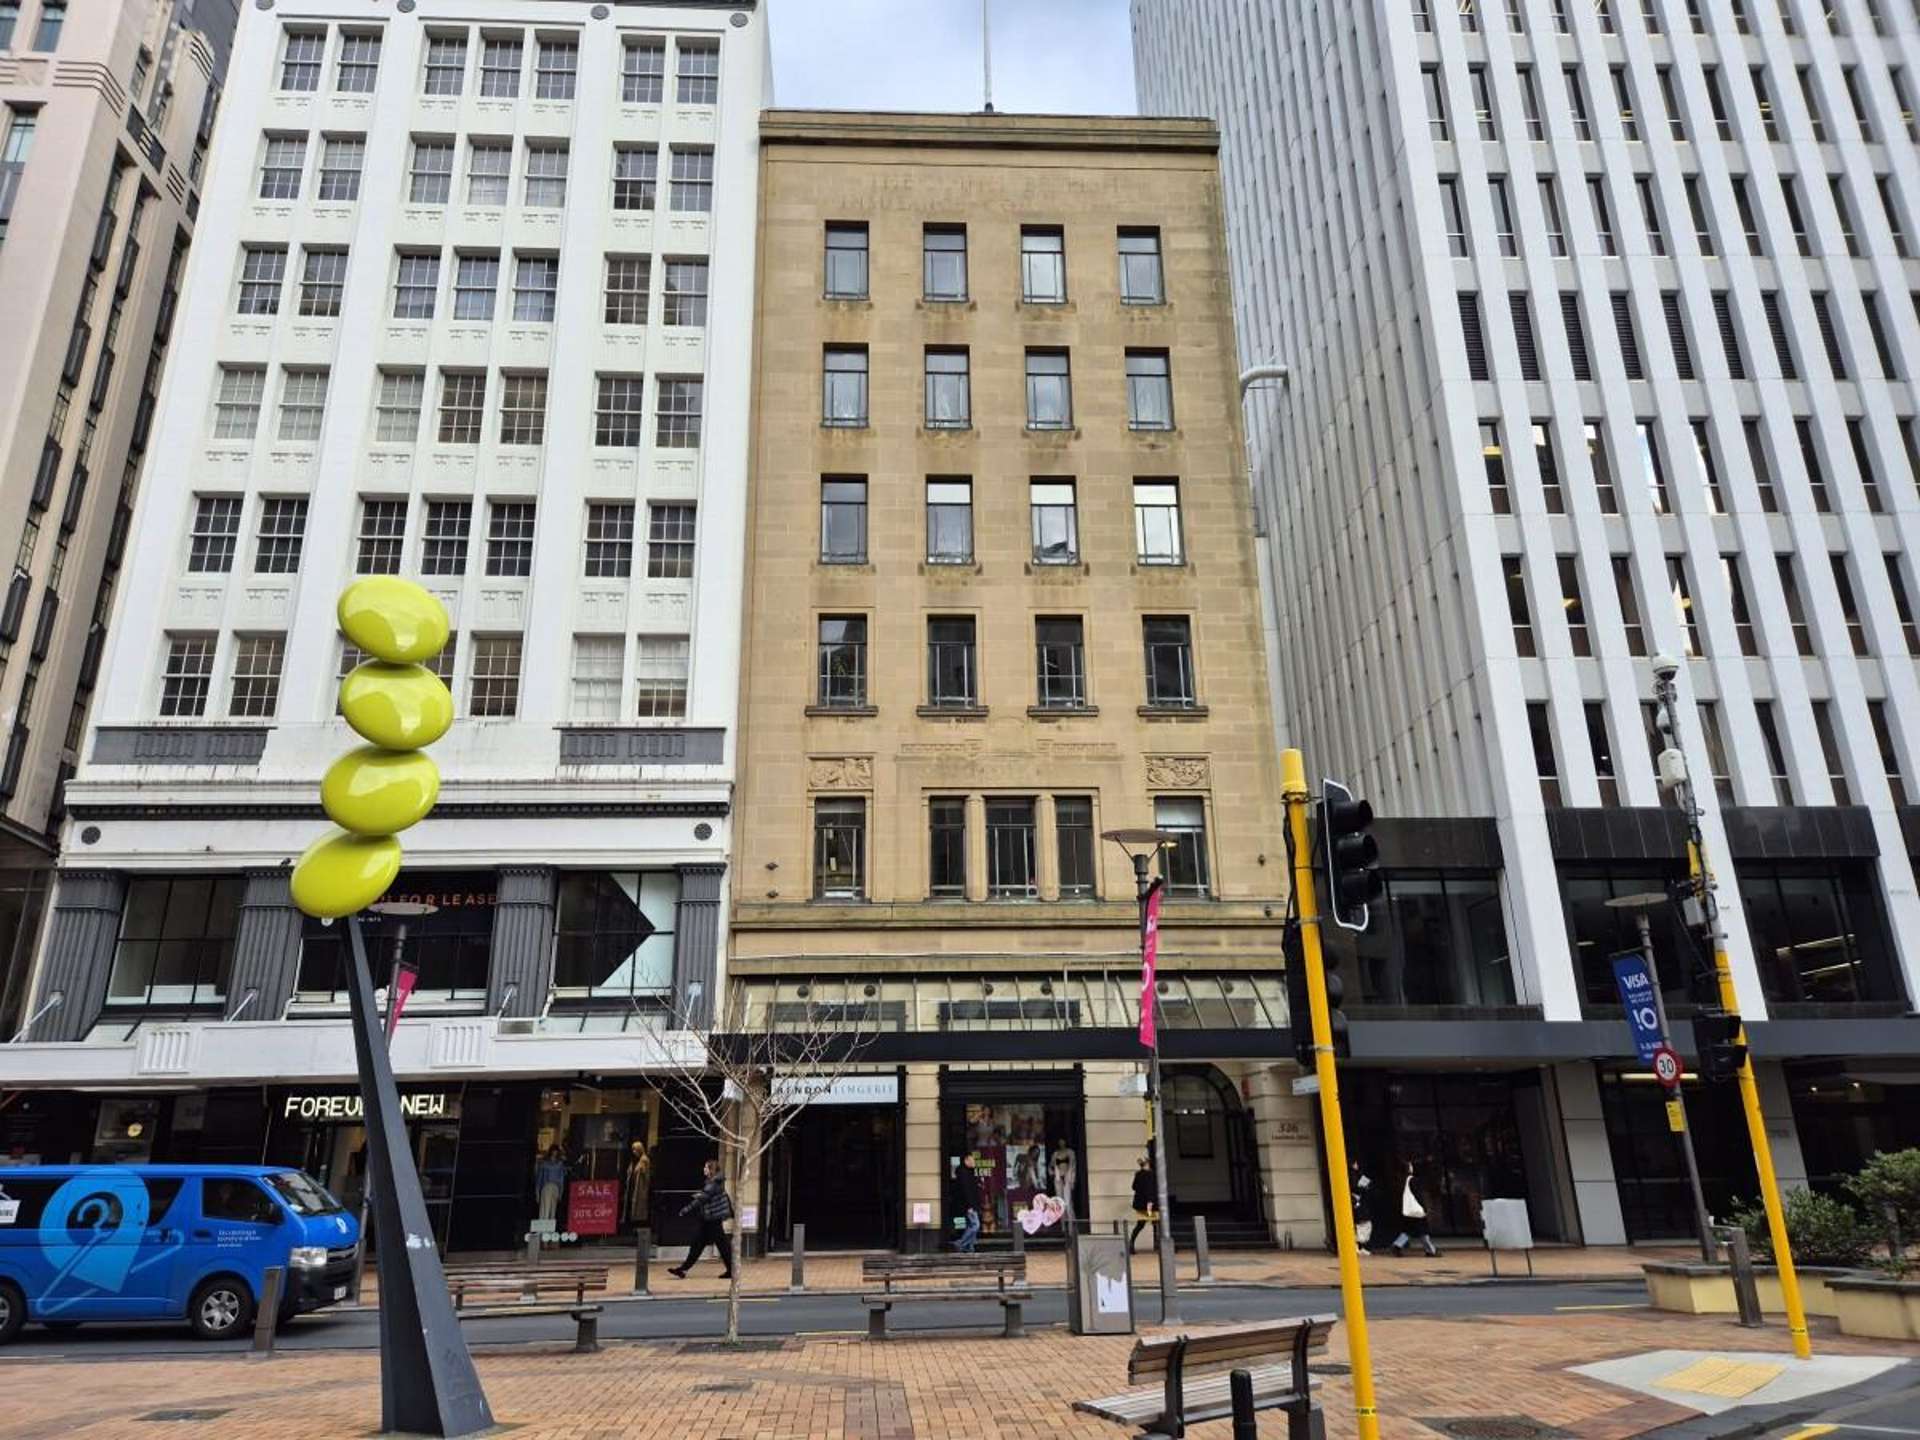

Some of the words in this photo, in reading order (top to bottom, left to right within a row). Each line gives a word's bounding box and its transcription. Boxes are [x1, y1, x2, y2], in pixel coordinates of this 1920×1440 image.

[442, 894, 497, 906] LEASE
[1623, 973, 1649, 988] VISA
[1659, 1058, 1674, 1073] 30
[284, 1095, 368, 1118] FOREV
[400, 1093, 444, 1115] NEW
[578, 1186, 611, 1197] SALE
